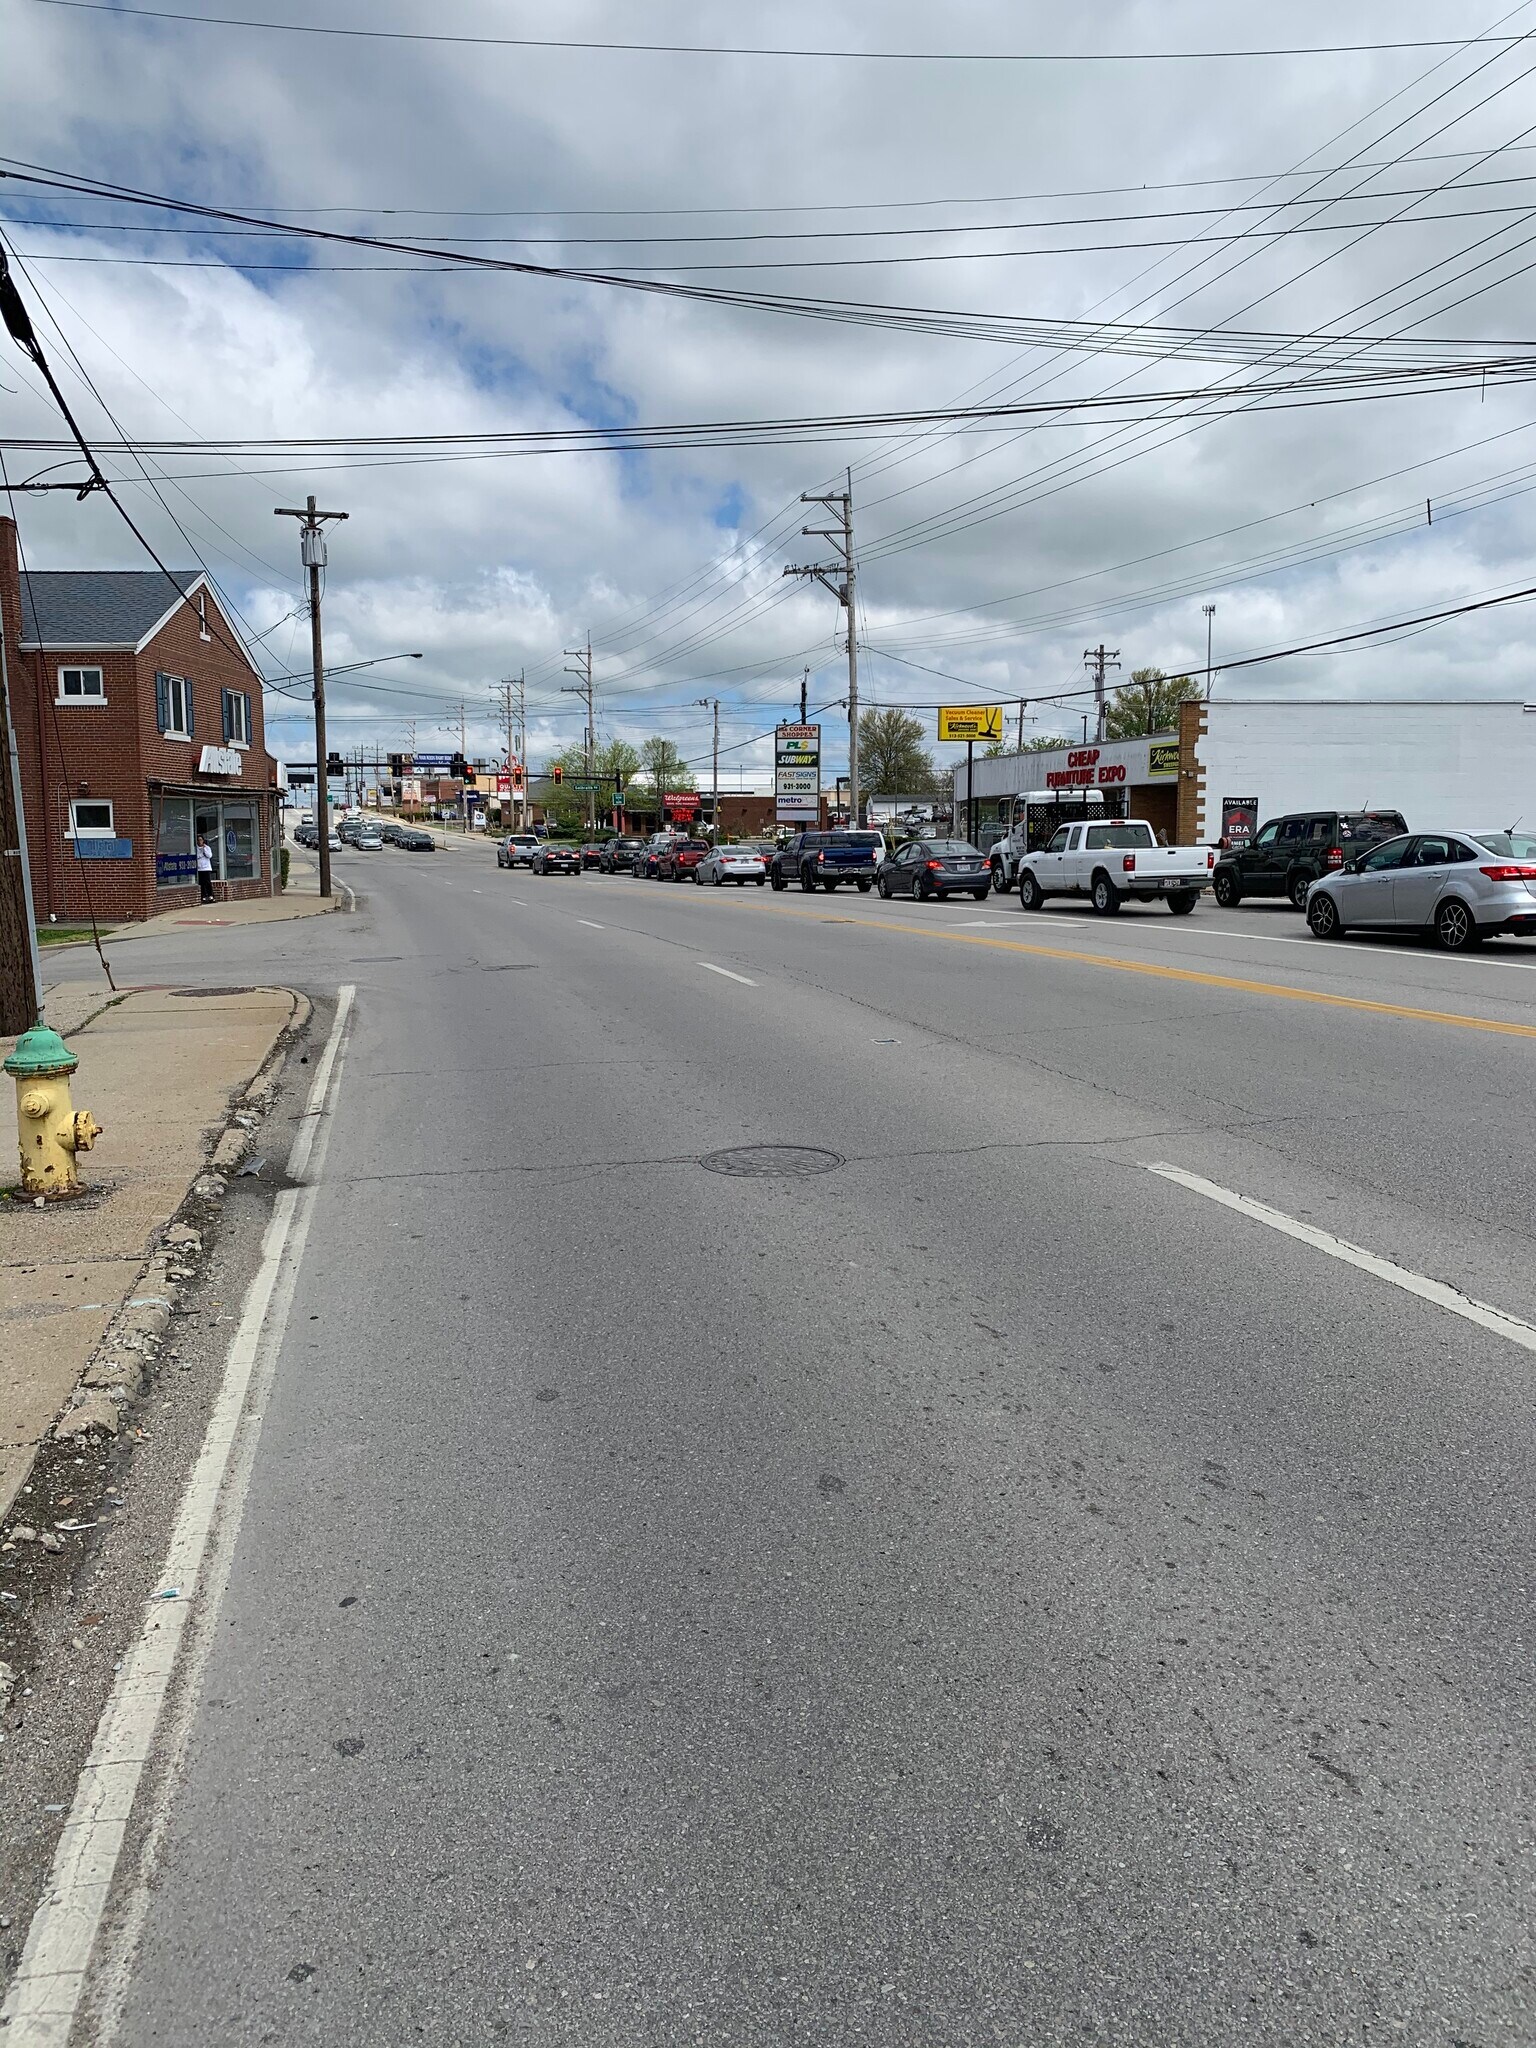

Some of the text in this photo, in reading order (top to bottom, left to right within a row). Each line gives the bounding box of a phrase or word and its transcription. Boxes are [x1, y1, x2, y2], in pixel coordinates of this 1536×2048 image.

[778, 755, 817, 764] SUBWAY
[1067, 749, 1100, 767] CHEAP
[1046, 765, 1126, 788] FURNITURE EXPO
